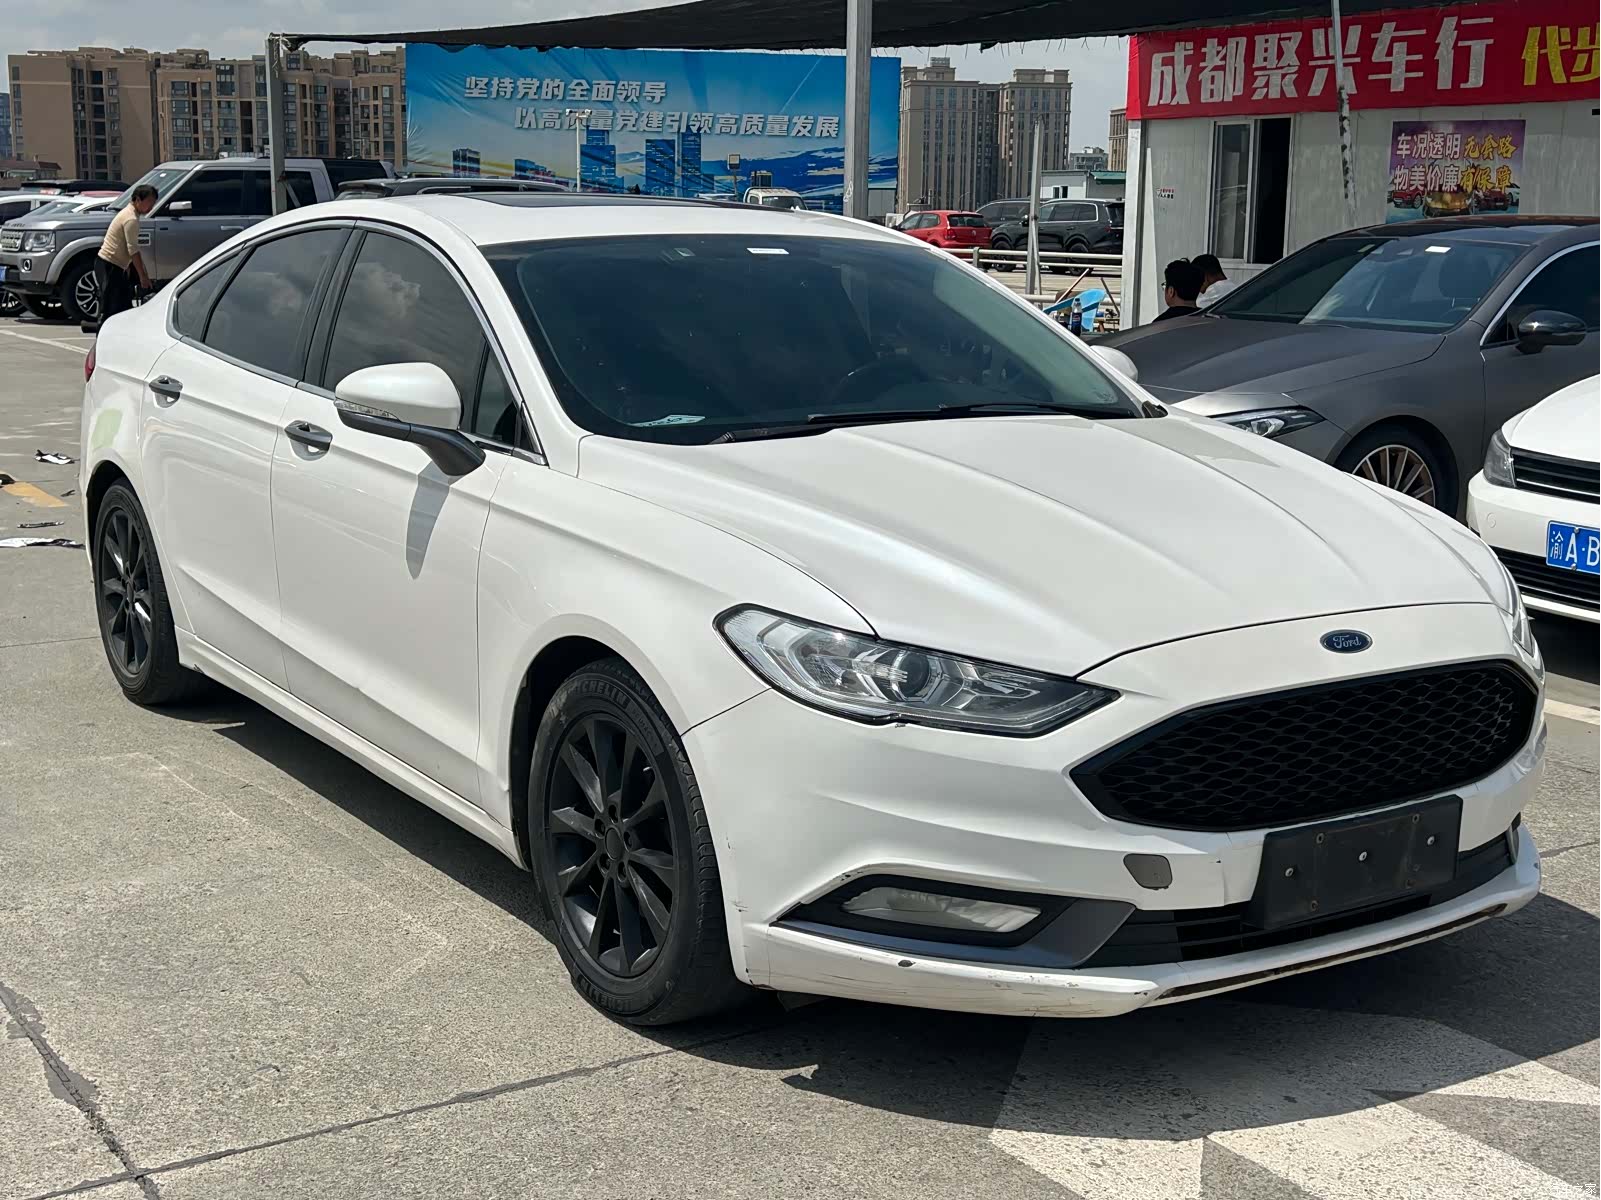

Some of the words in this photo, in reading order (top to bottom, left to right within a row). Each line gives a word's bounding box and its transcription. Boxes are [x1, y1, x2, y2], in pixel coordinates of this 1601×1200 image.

[1148, 16, 1494, 106] 成都聚兴车行
[1521, 22, 1600, 86] 代步
[464, 76, 667, 104] 坚持党的全面领导
[1396, 133, 1462, 160] 车况透明
[1393, 165, 1460, 192] 物美价廉
[1460, 165, 1512, 193] 有保障
[1332, 634, 1362, 649] Ford
